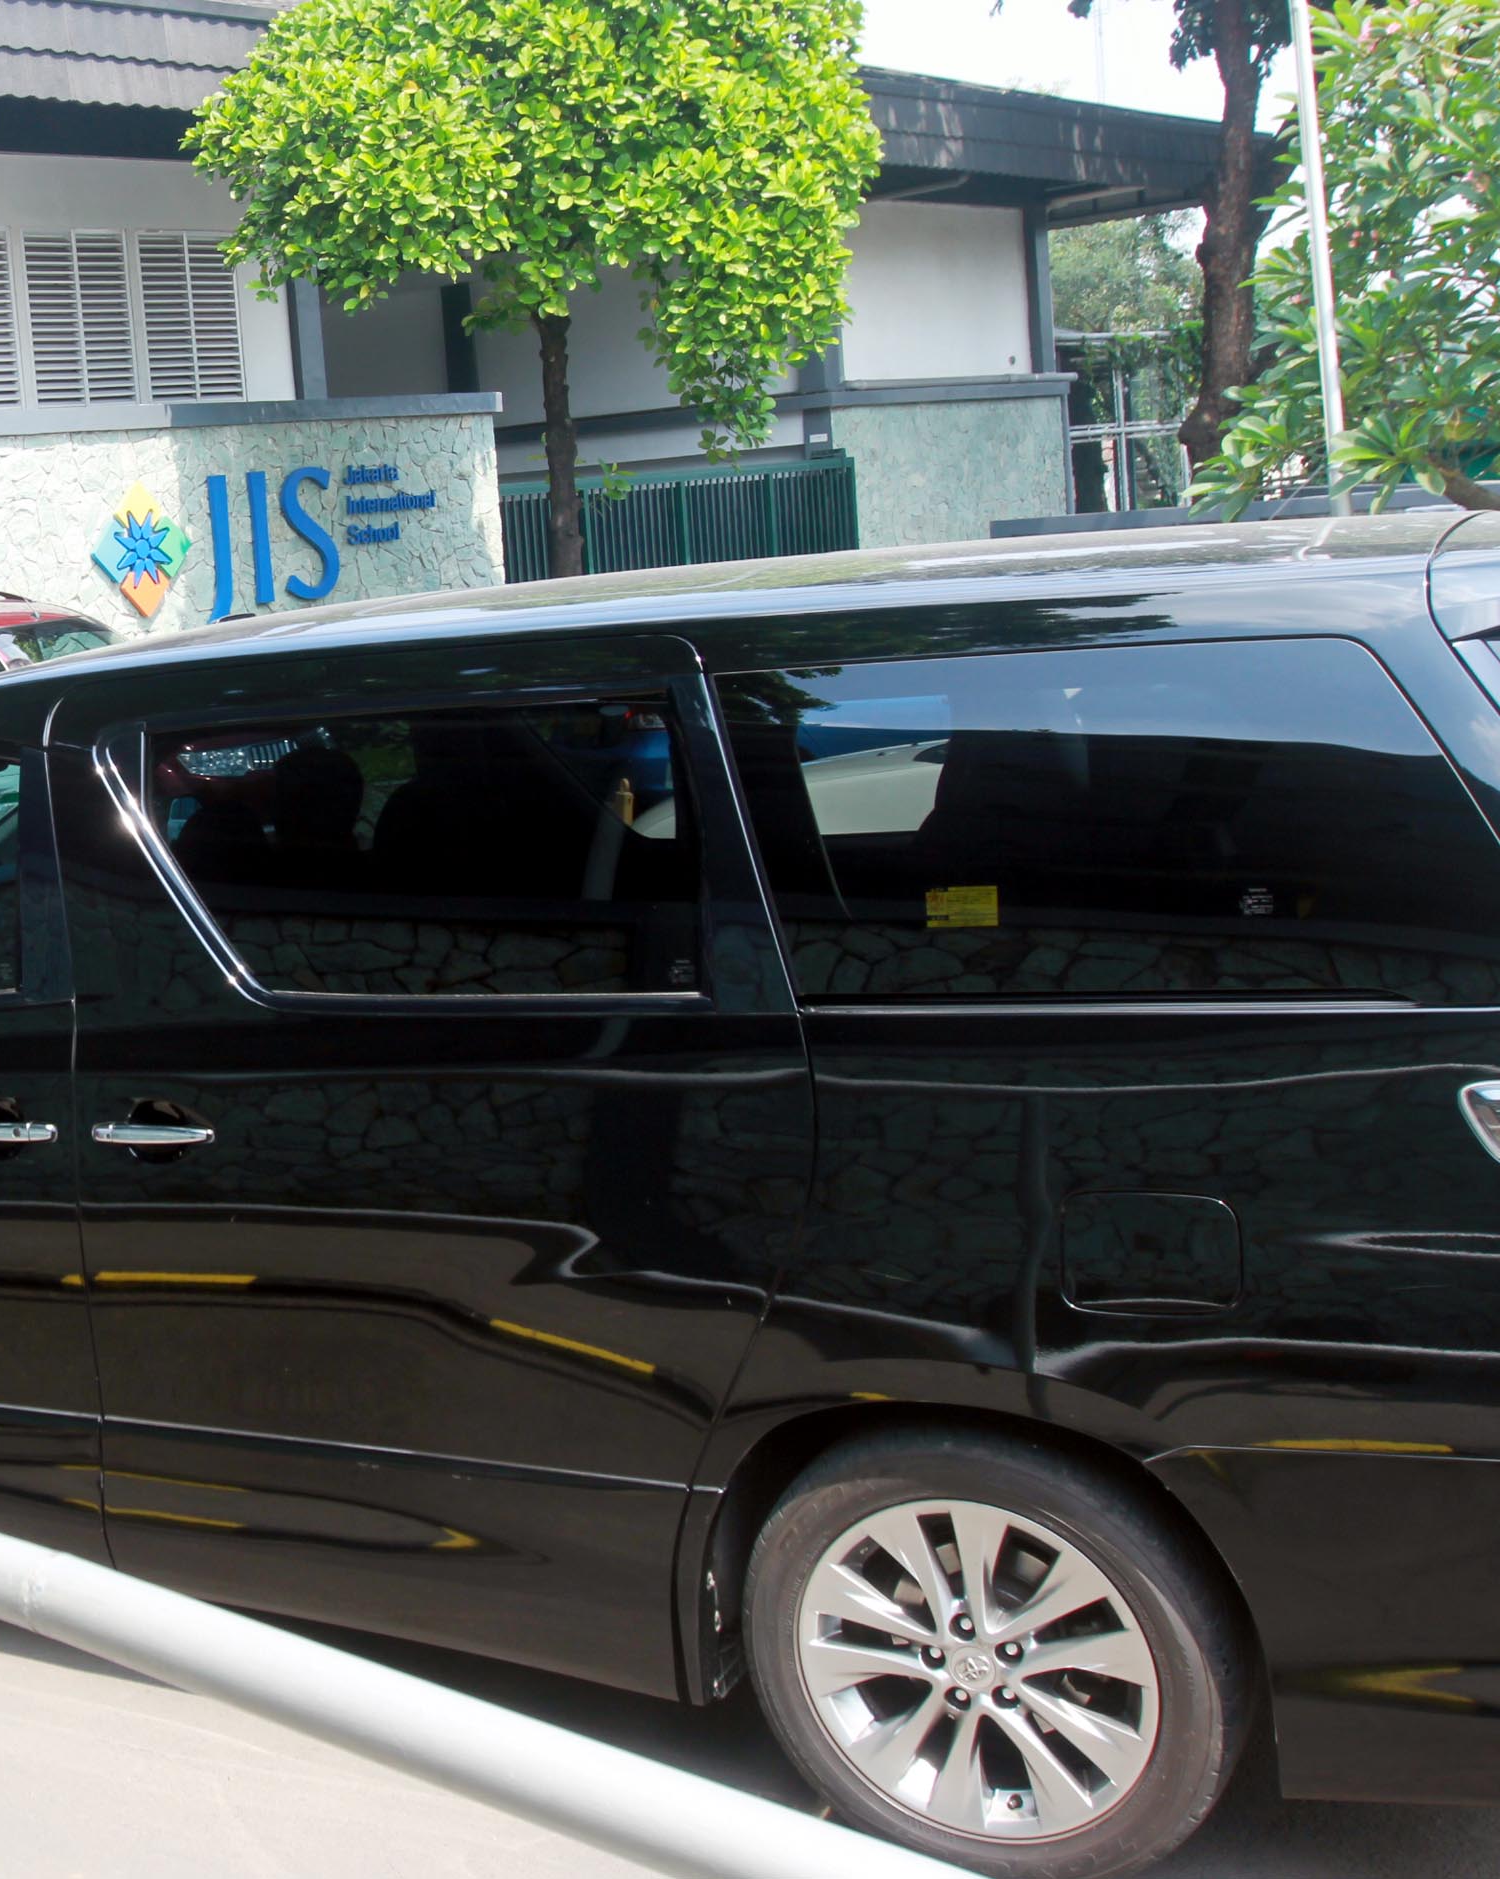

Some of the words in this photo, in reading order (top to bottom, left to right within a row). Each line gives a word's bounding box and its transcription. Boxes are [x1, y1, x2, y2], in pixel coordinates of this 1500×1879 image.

[343, 464, 399, 485] Jakarta
[346, 489, 436, 515] International
[207, 467, 340, 624] JIS
[347, 521, 400, 545] School
